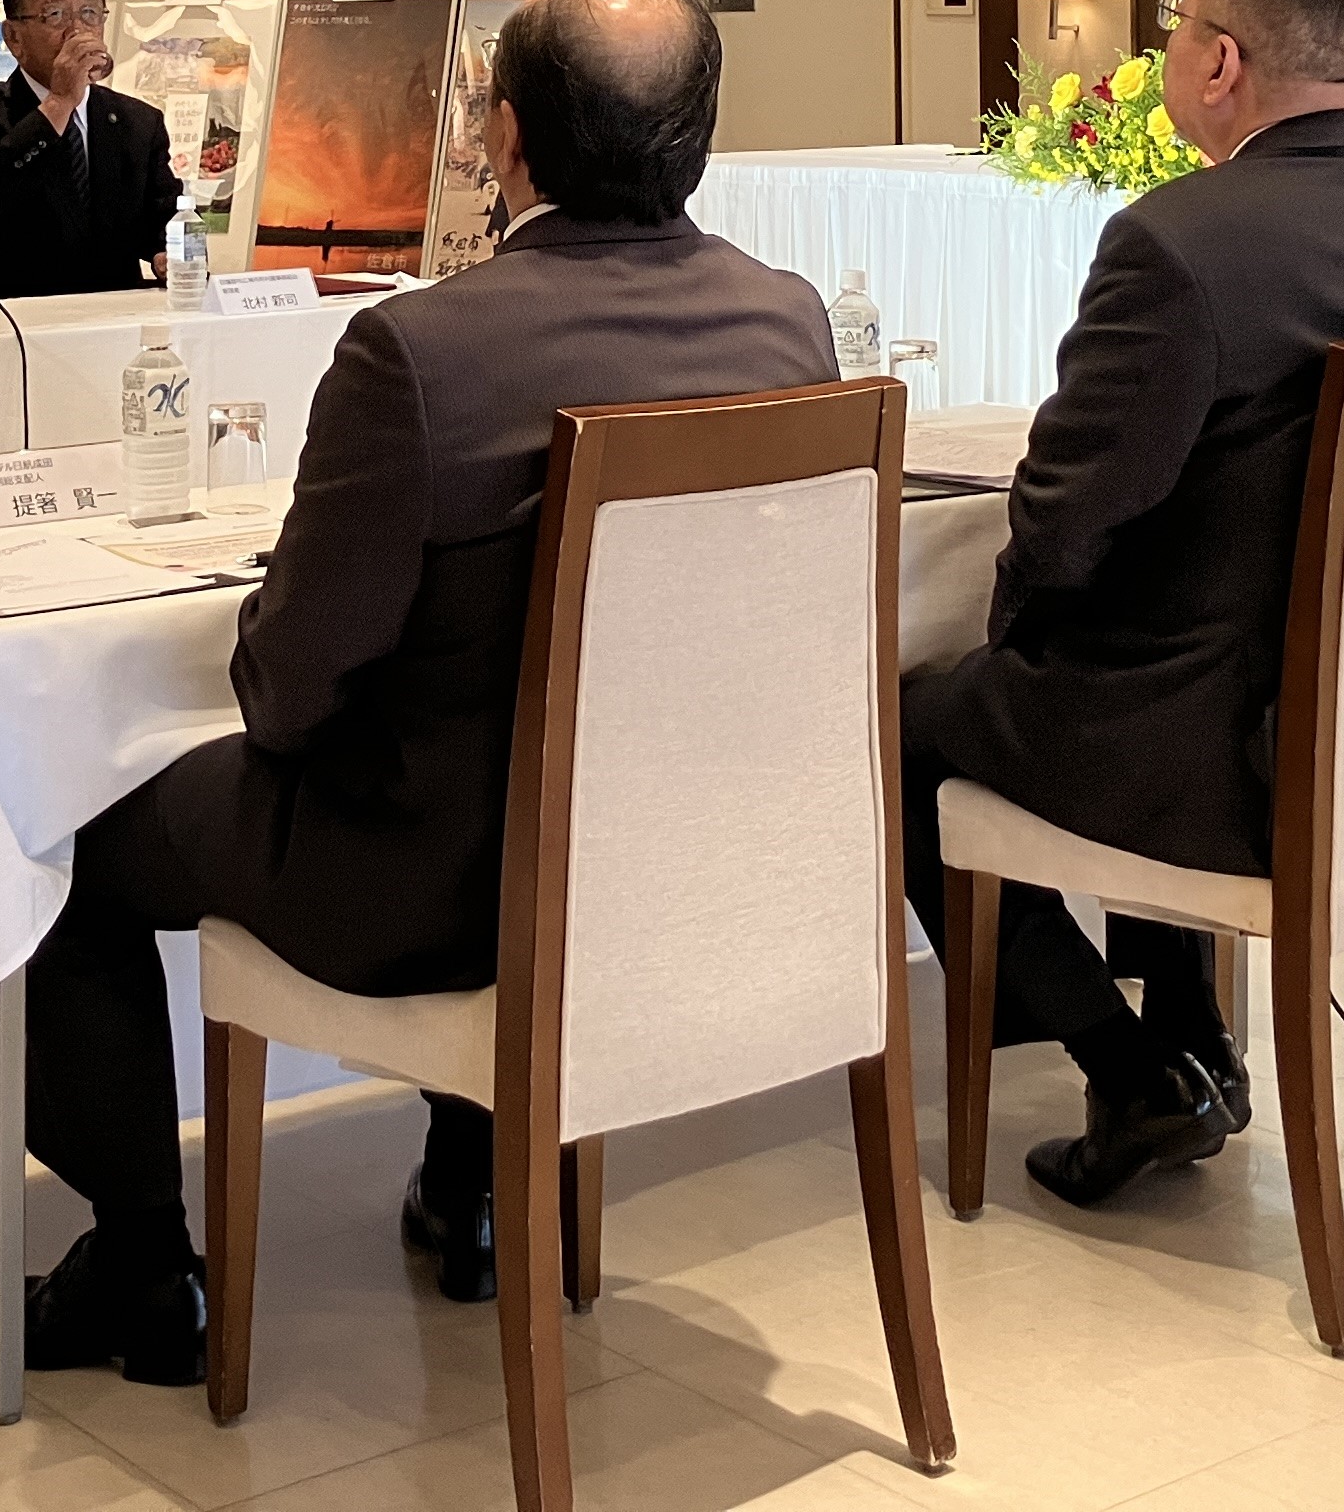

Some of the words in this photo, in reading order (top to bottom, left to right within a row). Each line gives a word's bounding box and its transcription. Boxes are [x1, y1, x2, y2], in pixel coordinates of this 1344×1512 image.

[366, 252, 407, 270] 佐倉市
[242, 295, 269, 310] 北村
[11, 491, 58, 519] 提箸
[72, 486, 118, 512] 賢一
